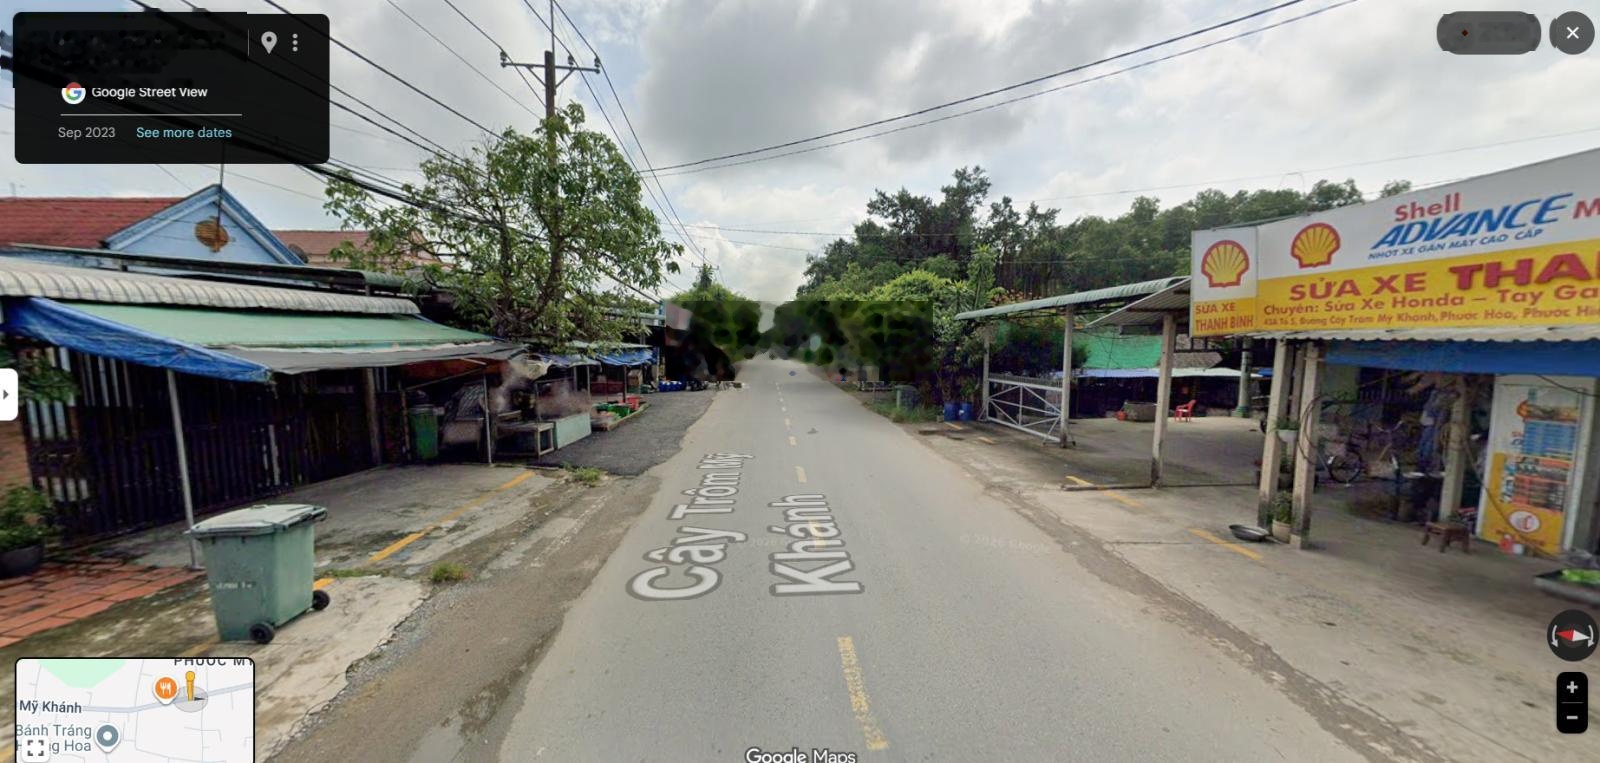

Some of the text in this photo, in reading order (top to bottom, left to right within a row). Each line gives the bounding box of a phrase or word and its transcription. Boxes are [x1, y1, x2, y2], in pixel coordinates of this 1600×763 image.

[1394, 192, 1460, 222] Shell
[1370, 193, 1574, 250] ADVANCE
[1371, 272, 1427, 295] XE
[1222, 302, 1236, 312] XE
[1361, 298, 1385, 310] Xe
[1391, 293, 1465, 308] Honda
[1497, 288, 1544, 306] Tay
